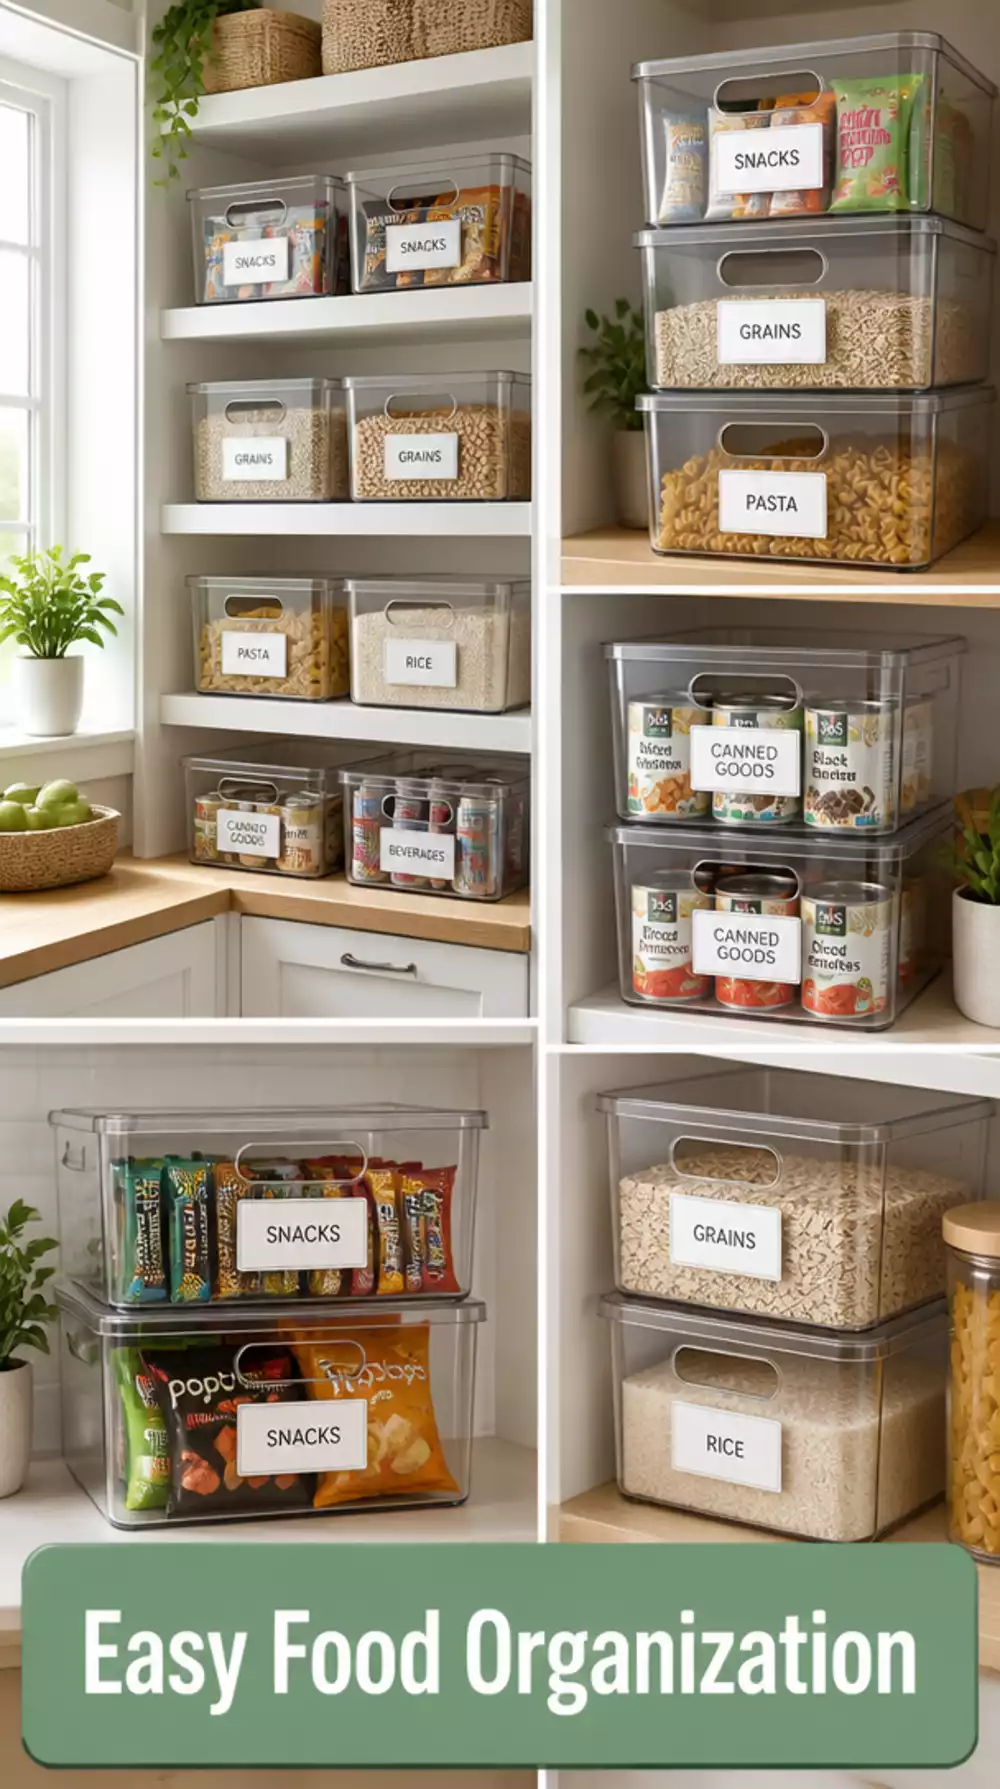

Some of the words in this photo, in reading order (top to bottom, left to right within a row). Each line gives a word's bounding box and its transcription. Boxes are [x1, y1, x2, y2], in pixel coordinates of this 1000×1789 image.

[734, 148, 801, 170] SNACKS
[400, 238, 447, 254] SNACKS
[235, 254, 276, 269] SNACKS
[739, 322, 802, 340] GRAINS
[234, 453, 273, 466] GRAINS
[397, 449, 442, 464] GRAINS
[746, 493, 798, 512] PASTA
[237, 647, 270, 661] PASTA
[405, 655, 433, 670] RICE
[710, 742, 779, 761] CANNED
[714, 760, 776, 779] GOODS
[713, 926, 780, 947] CANNED
[716, 944, 778, 965] GOODS
[266, 1223, 341, 1245] SNACKS
[693, 1223, 756, 1250] GRAINS
[266, 1425, 342, 1449] SNACKS
[706, 1434, 745, 1459] RICE
